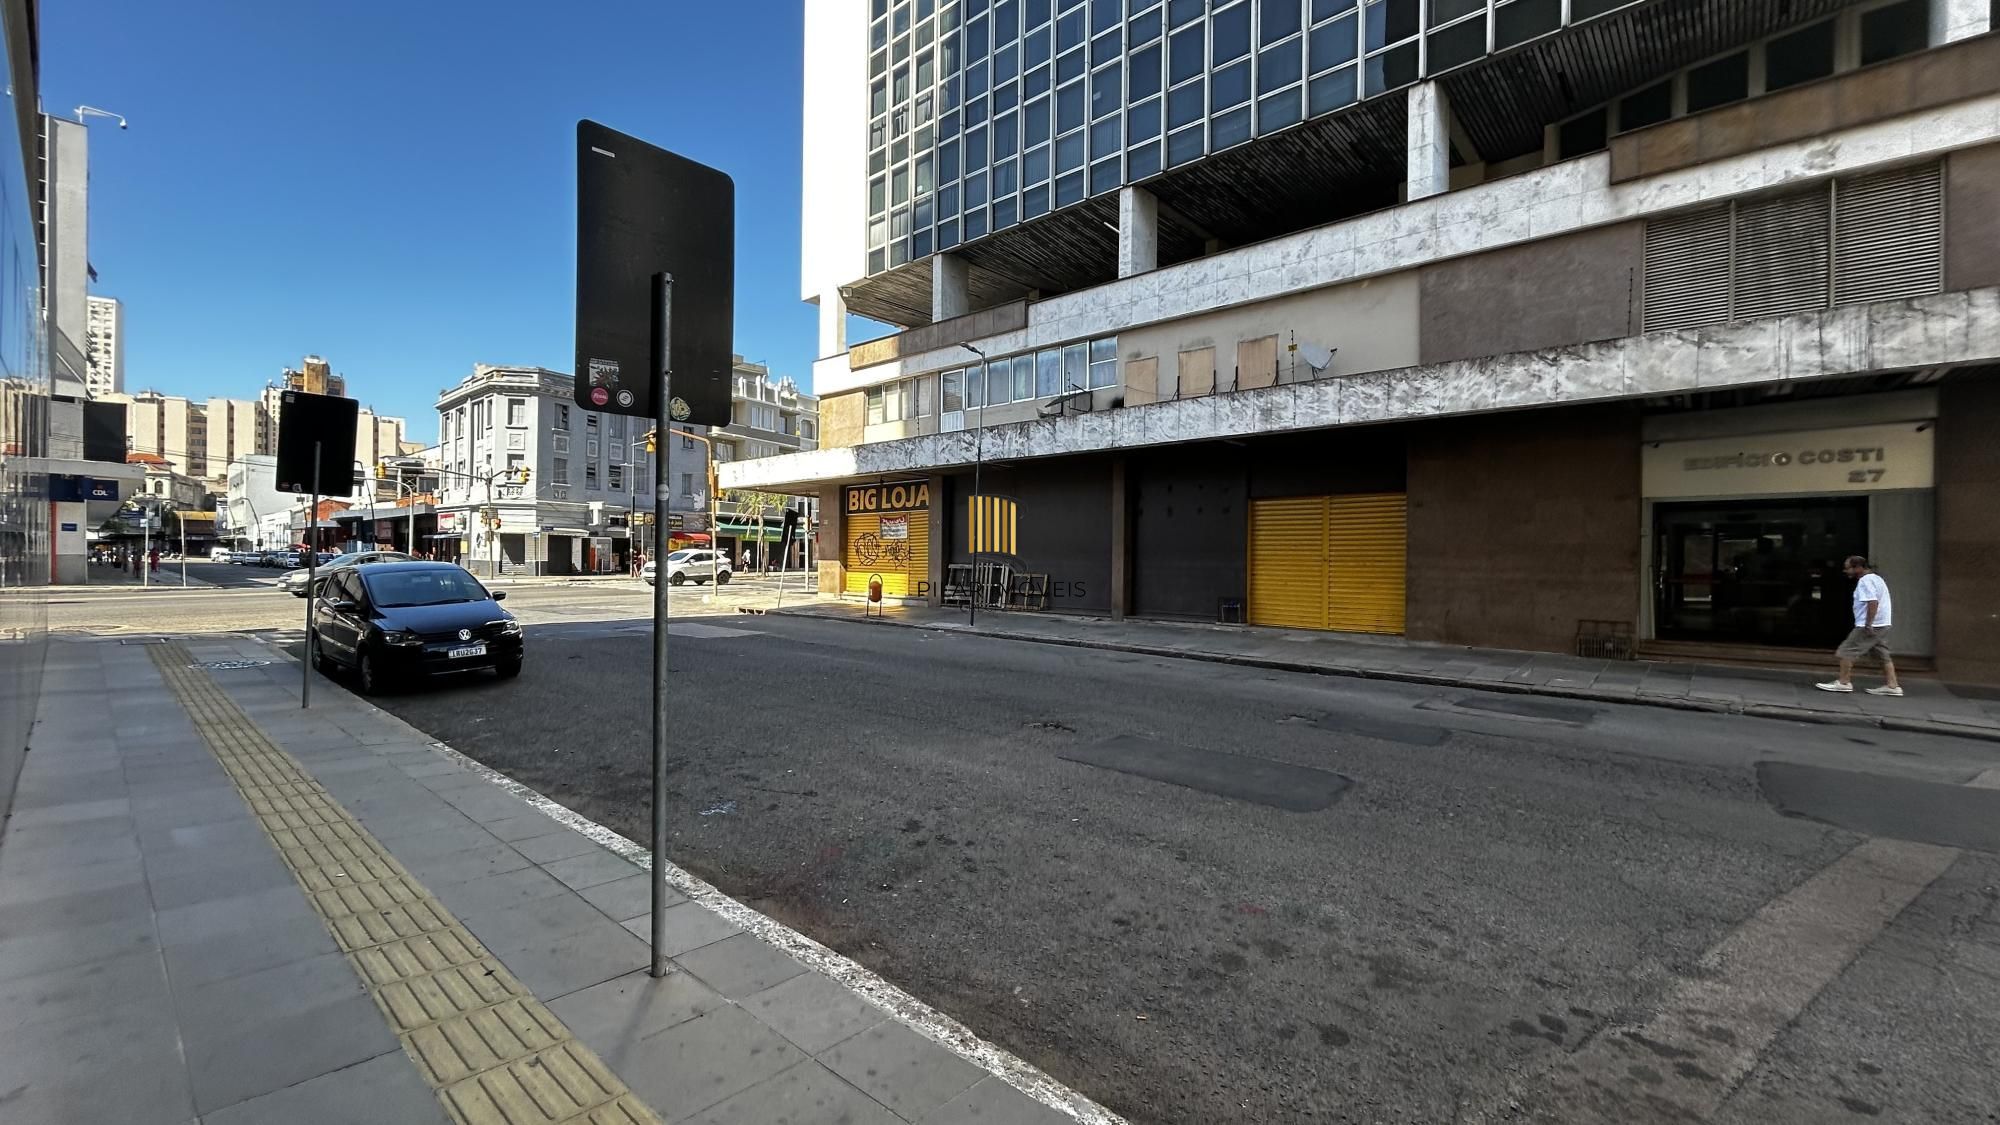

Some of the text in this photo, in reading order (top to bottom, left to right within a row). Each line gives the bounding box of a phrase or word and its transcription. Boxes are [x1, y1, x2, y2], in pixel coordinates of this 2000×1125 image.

[1798, 447, 1884, 465] COSTI
[1847, 469, 1886, 483] 27
[848, 484, 929, 511] BIG LOJA
